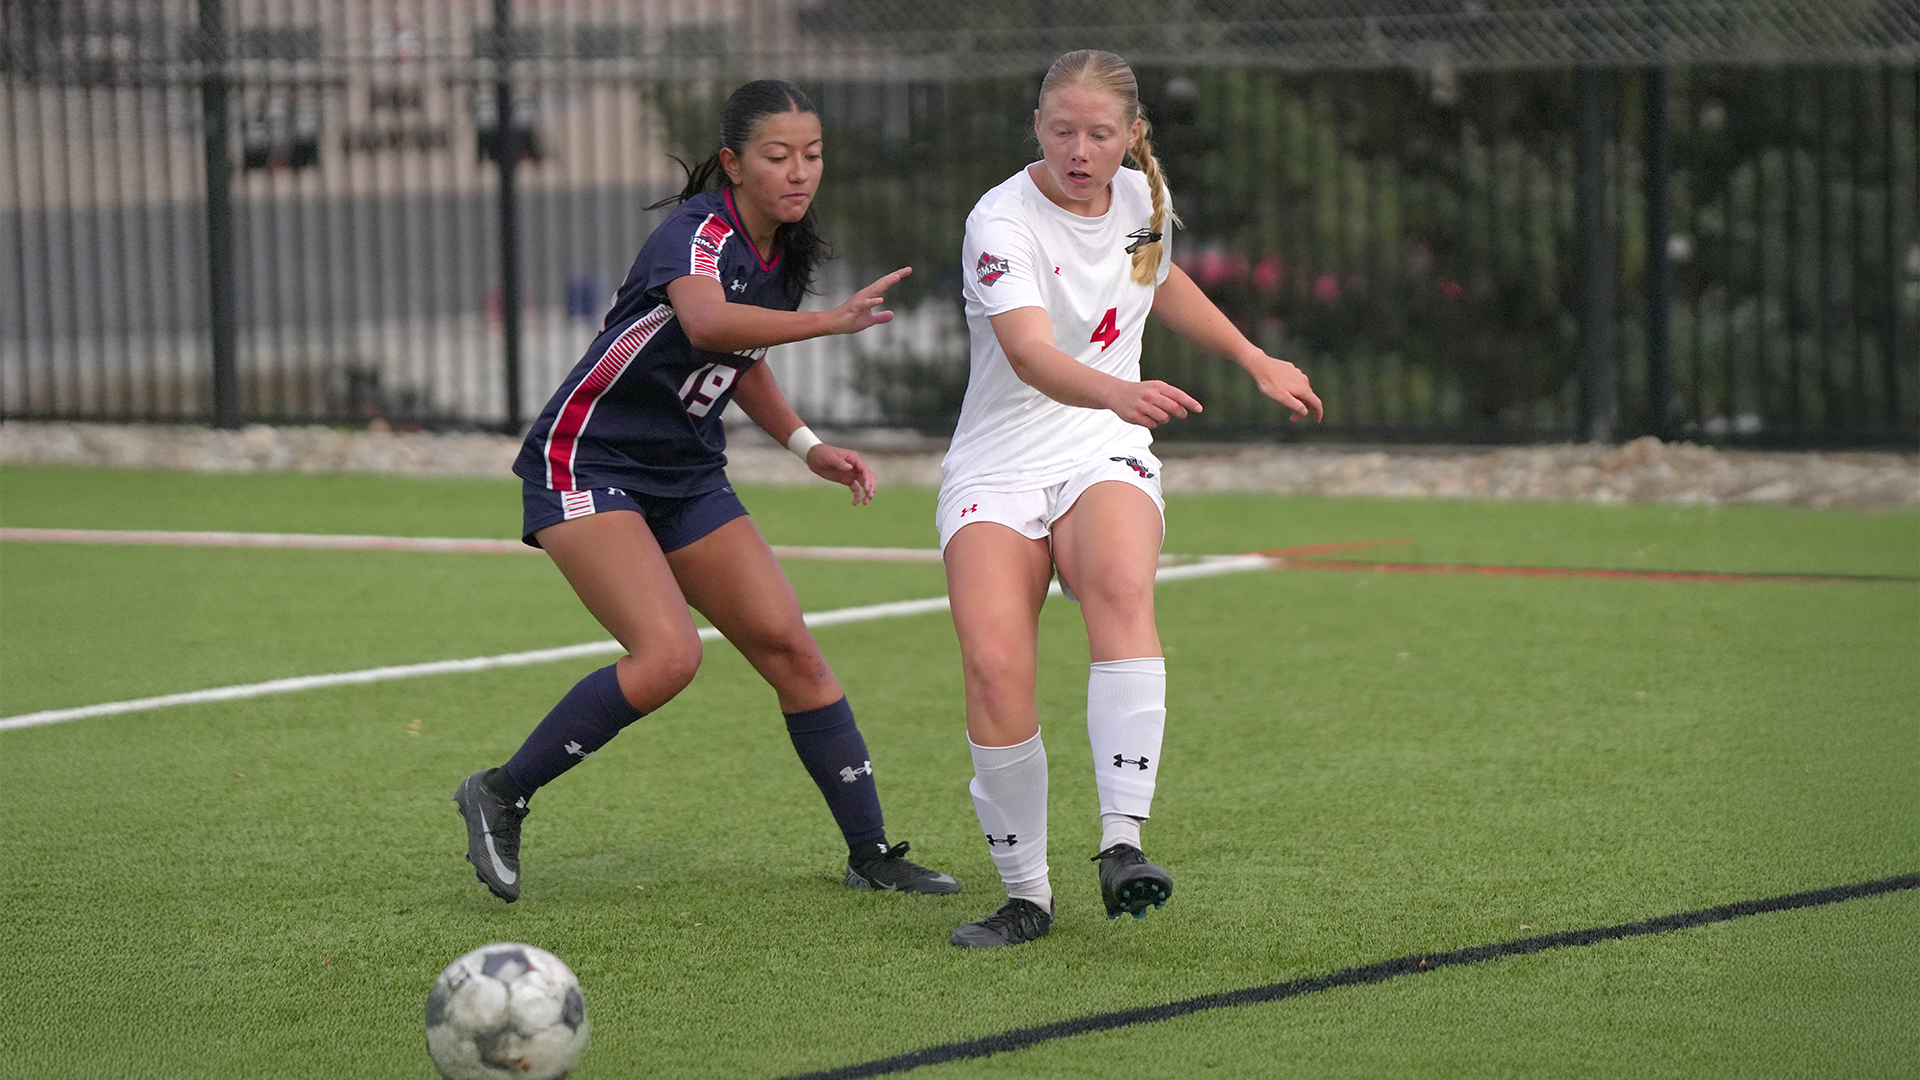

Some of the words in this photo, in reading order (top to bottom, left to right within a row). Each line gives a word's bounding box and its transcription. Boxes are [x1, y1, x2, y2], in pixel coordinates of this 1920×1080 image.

[978, 261, 1008, 278] RMAC
[1089, 307, 1120, 353] 4
[678, 362, 739, 418] 19
